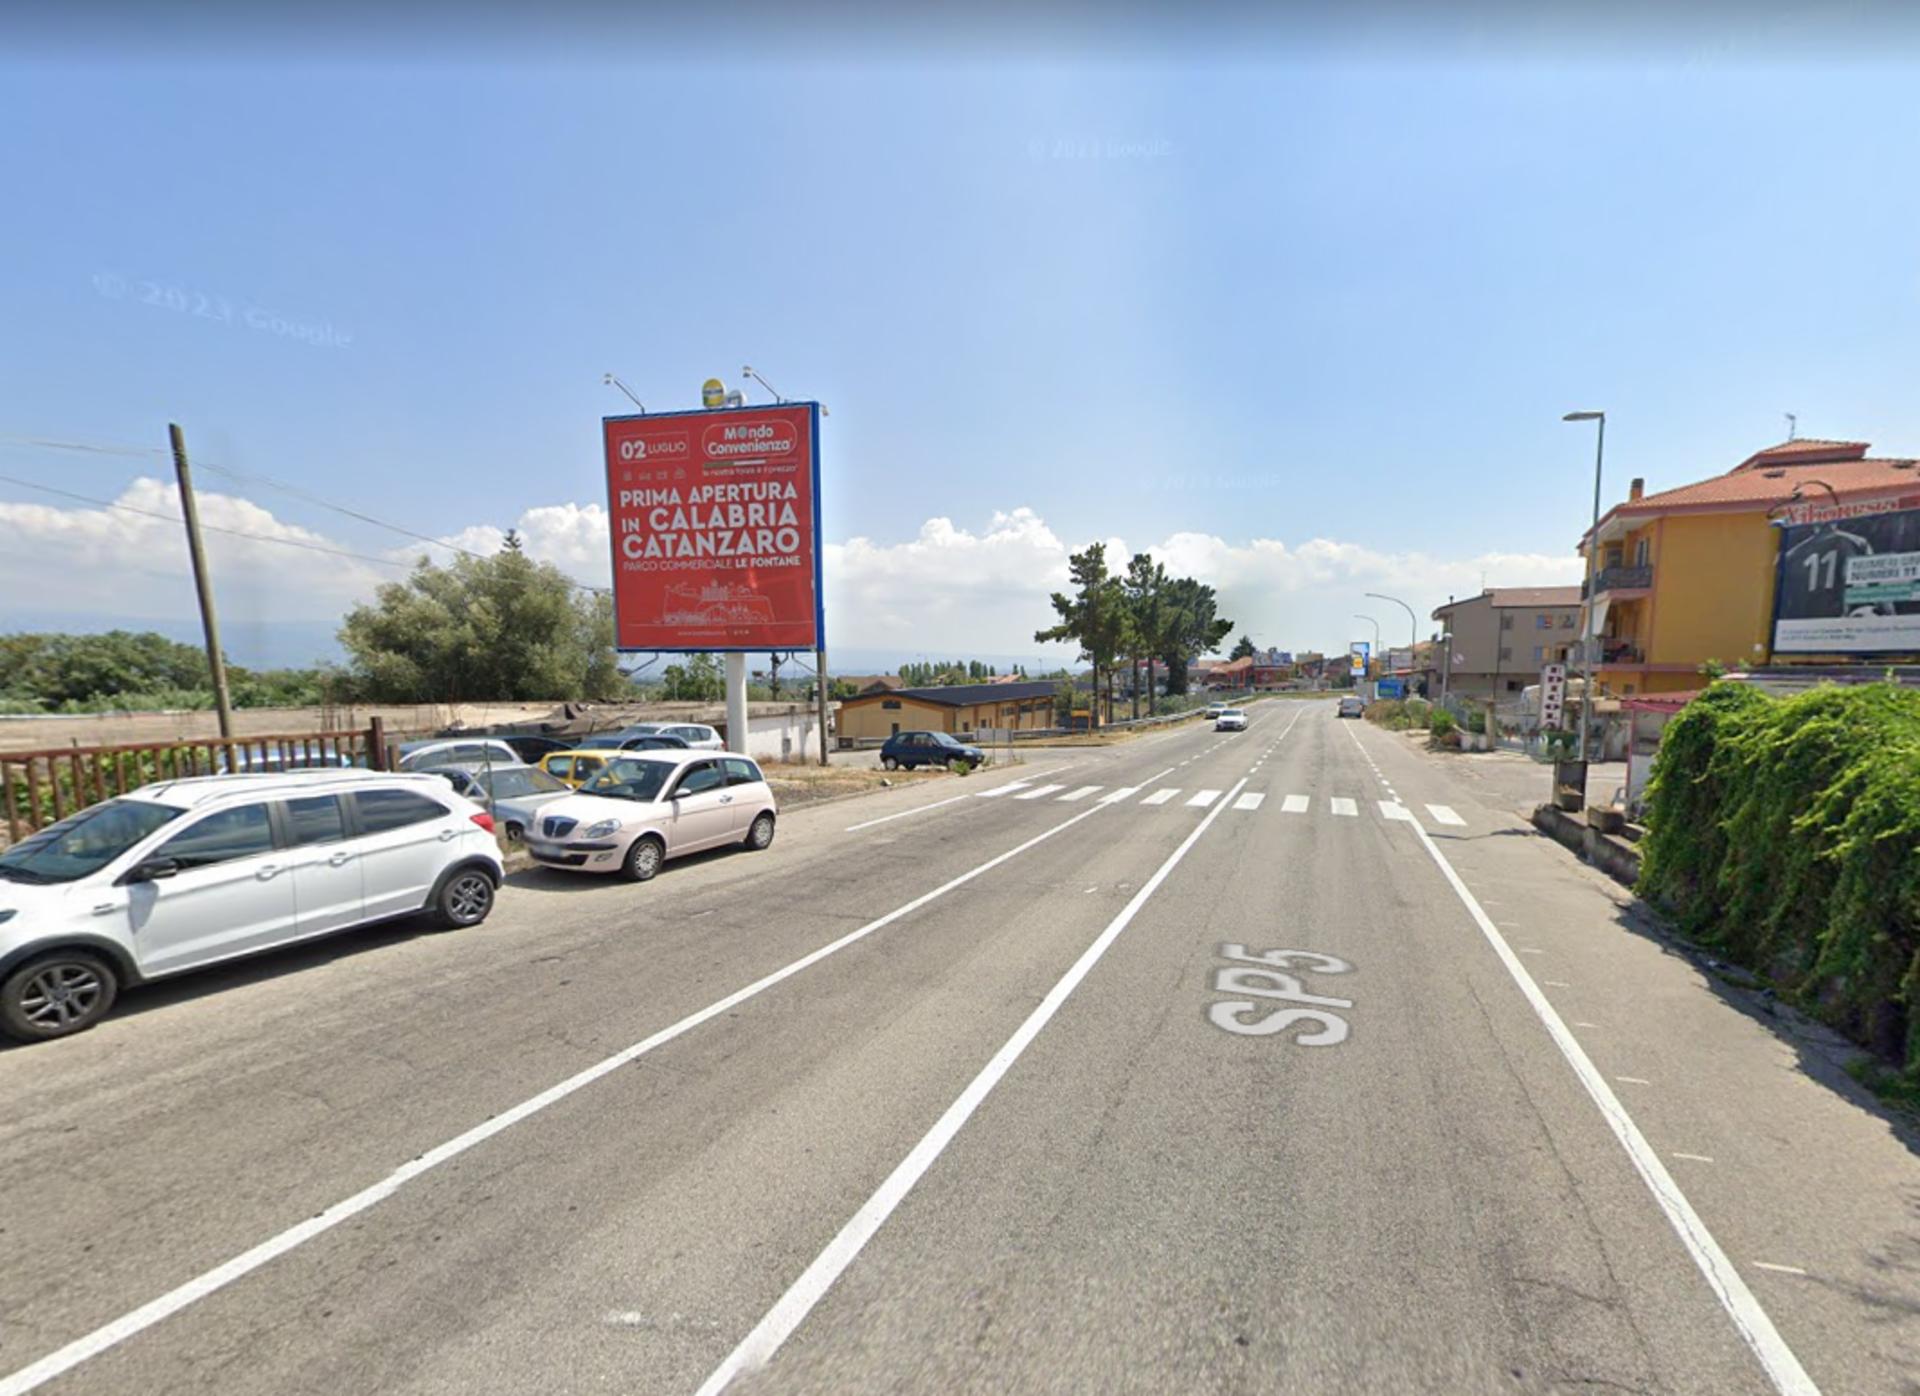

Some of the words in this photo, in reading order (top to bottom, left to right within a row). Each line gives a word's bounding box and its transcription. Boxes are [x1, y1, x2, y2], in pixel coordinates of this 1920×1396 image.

[620, 440, 647, 460] 02
[648, 441, 687, 455] LUGLIO
[707, 438, 790, 455] Convenienza
[620, 488, 683, 508] PRIMA
[688, 482, 798, 504] APERTURA
[621, 518, 640, 533] IN
[649, 502, 798, 531] CALABRIA
[622, 528, 800, 560] CATANZARO
[623, 559, 658, 572] PARCO
[659, 559, 733, 571] COMMERCIALE
[735, 556, 749, 568] LE
[750, 555, 801, 568] FONTANE
[1804, 550, 1837, 592] 11
[1210, 943, 1354, 1046] SP5
